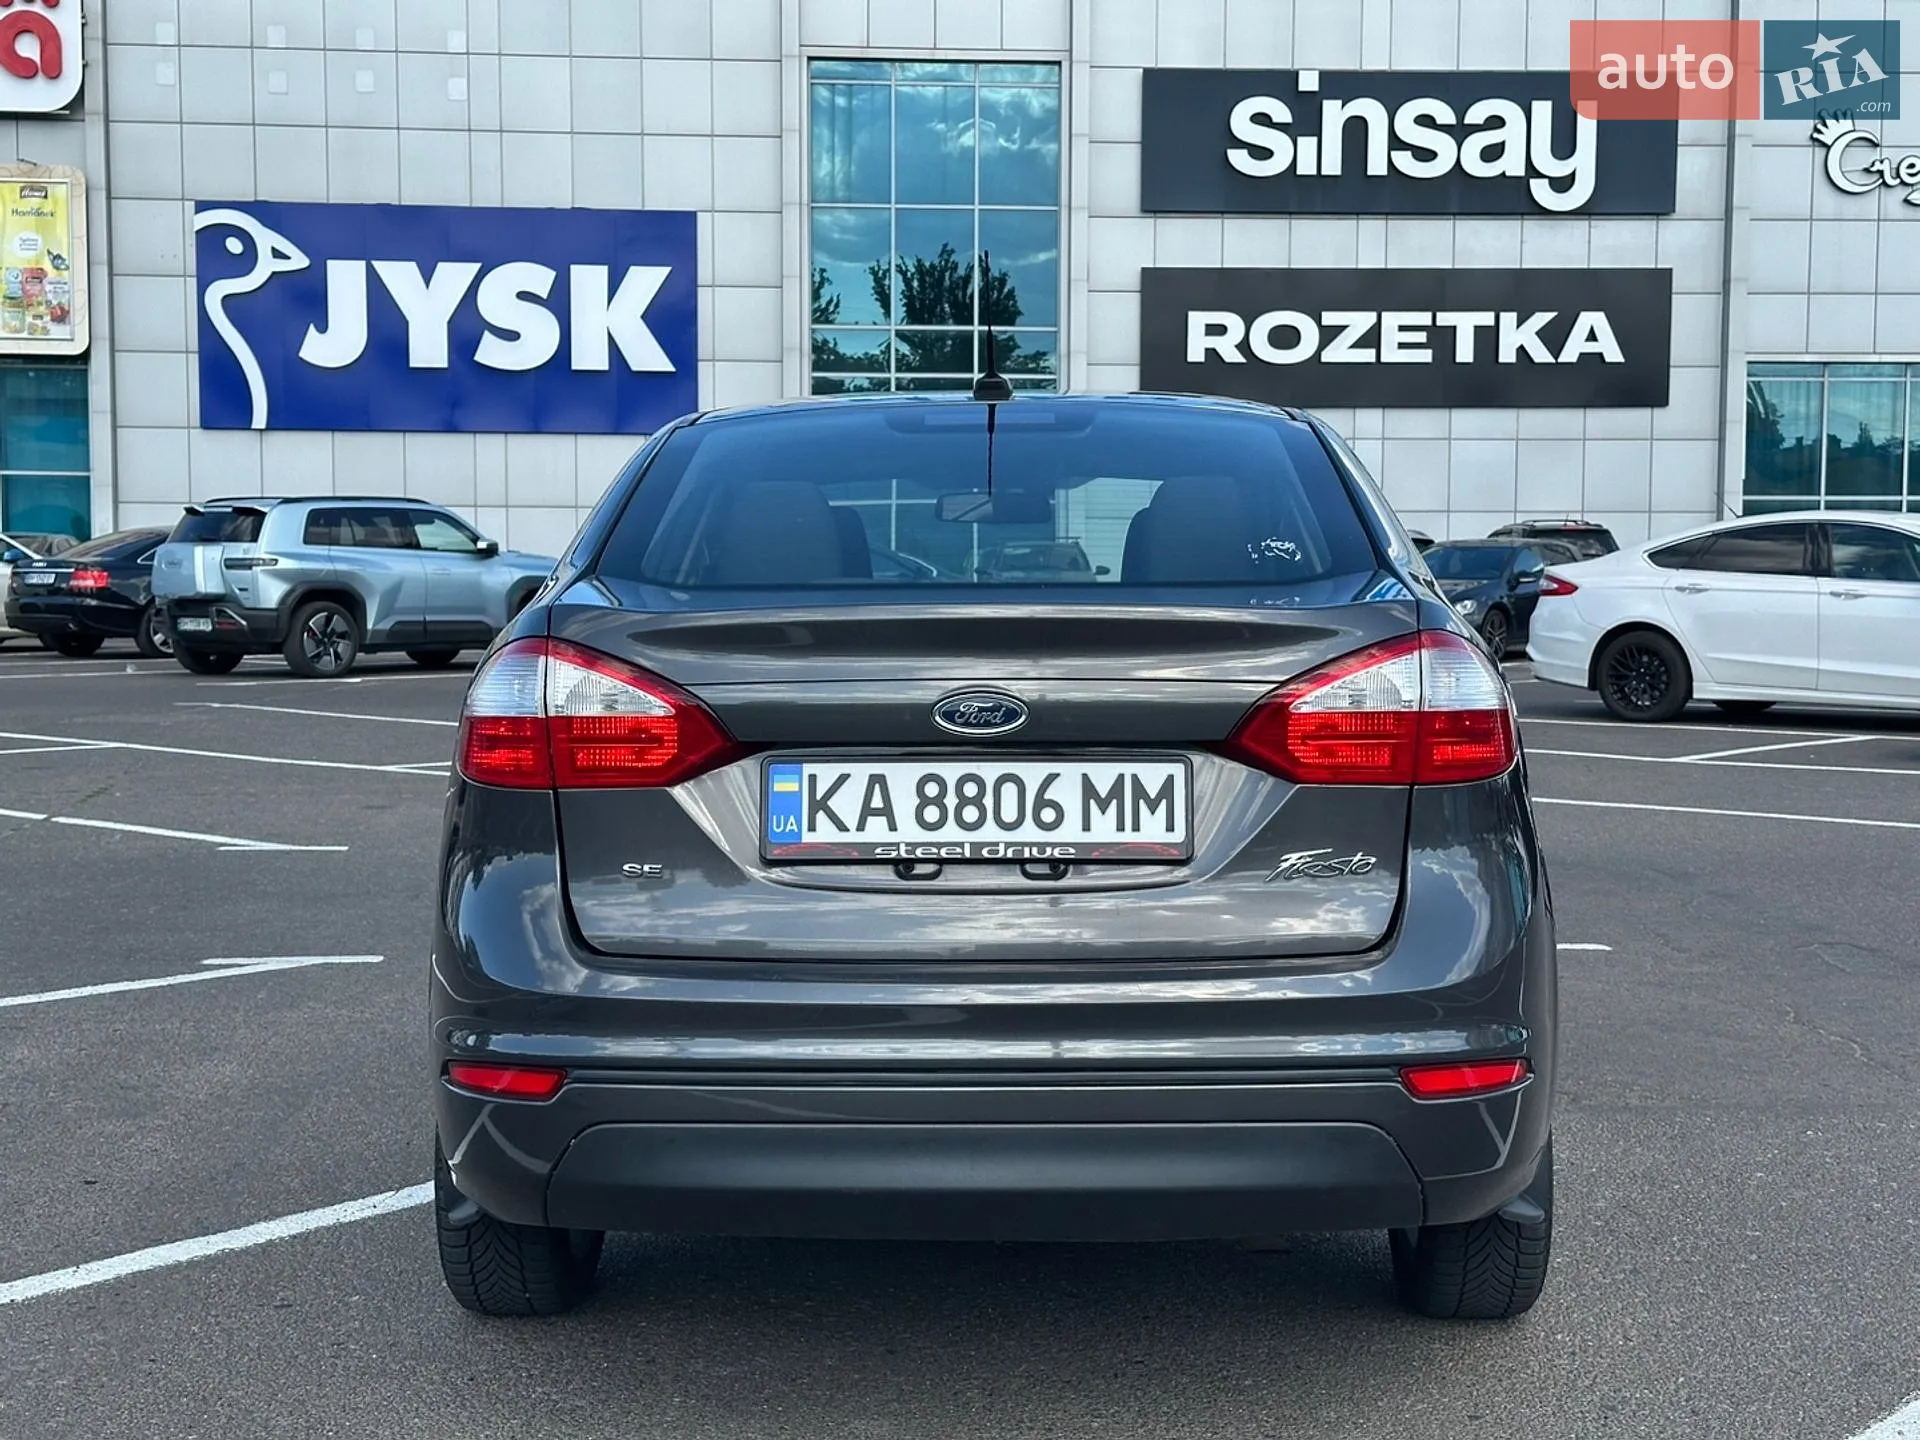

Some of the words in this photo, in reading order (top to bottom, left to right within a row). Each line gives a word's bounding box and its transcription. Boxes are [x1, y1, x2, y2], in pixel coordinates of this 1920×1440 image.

[1226, 69, 1598, 212] sinsay
[299, 259, 677, 372] JYSK
[1186, 310, 1625, 364] ROZETKA
[954, 702, 1007, 724] Ford
[807, 773, 898, 833] KA
[915, 772, 1065, 833] 8806
[1081, 773, 1175, 833] MM
[772, 815, 798, 833] UA
[874, 842, 972, 859] steel
[981, 842, 1076, 859] drive
[1265, 848, 1377, 881] Fiesta
[622, 863, 664, 878] SE
